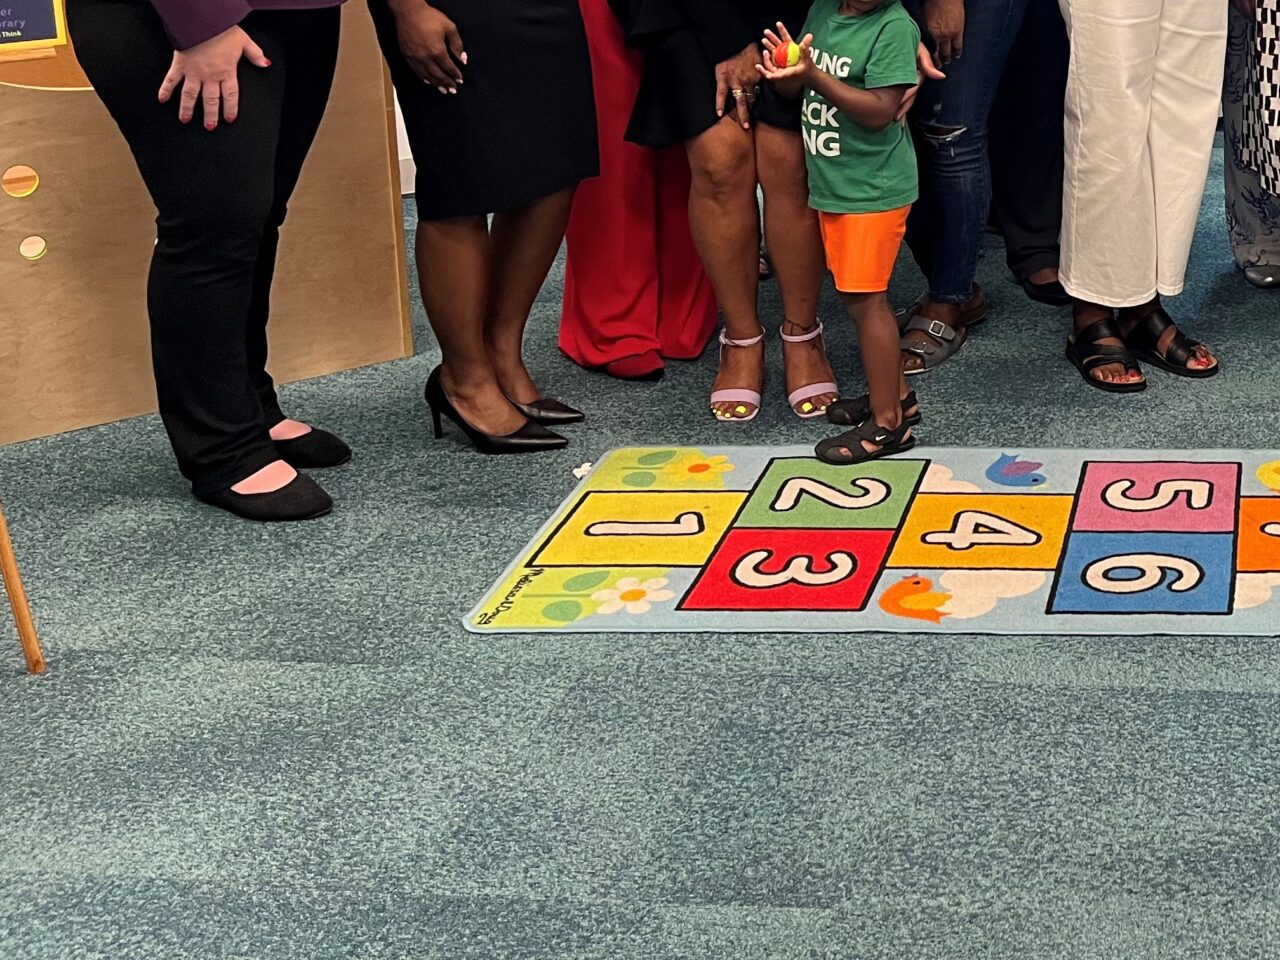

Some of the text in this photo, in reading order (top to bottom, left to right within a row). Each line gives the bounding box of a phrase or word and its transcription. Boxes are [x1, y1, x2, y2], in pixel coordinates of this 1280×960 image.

[1, 30, 22, 38] Think
[768, 476, 893, 514] 2
[1099, 475, 1216, 512] 5
[582, 510, 706, 538] 1
[919, 509, 1043, 551] 4
[732, 546, 859, 590] 3
[1085, 551, 1206, 595] 6
